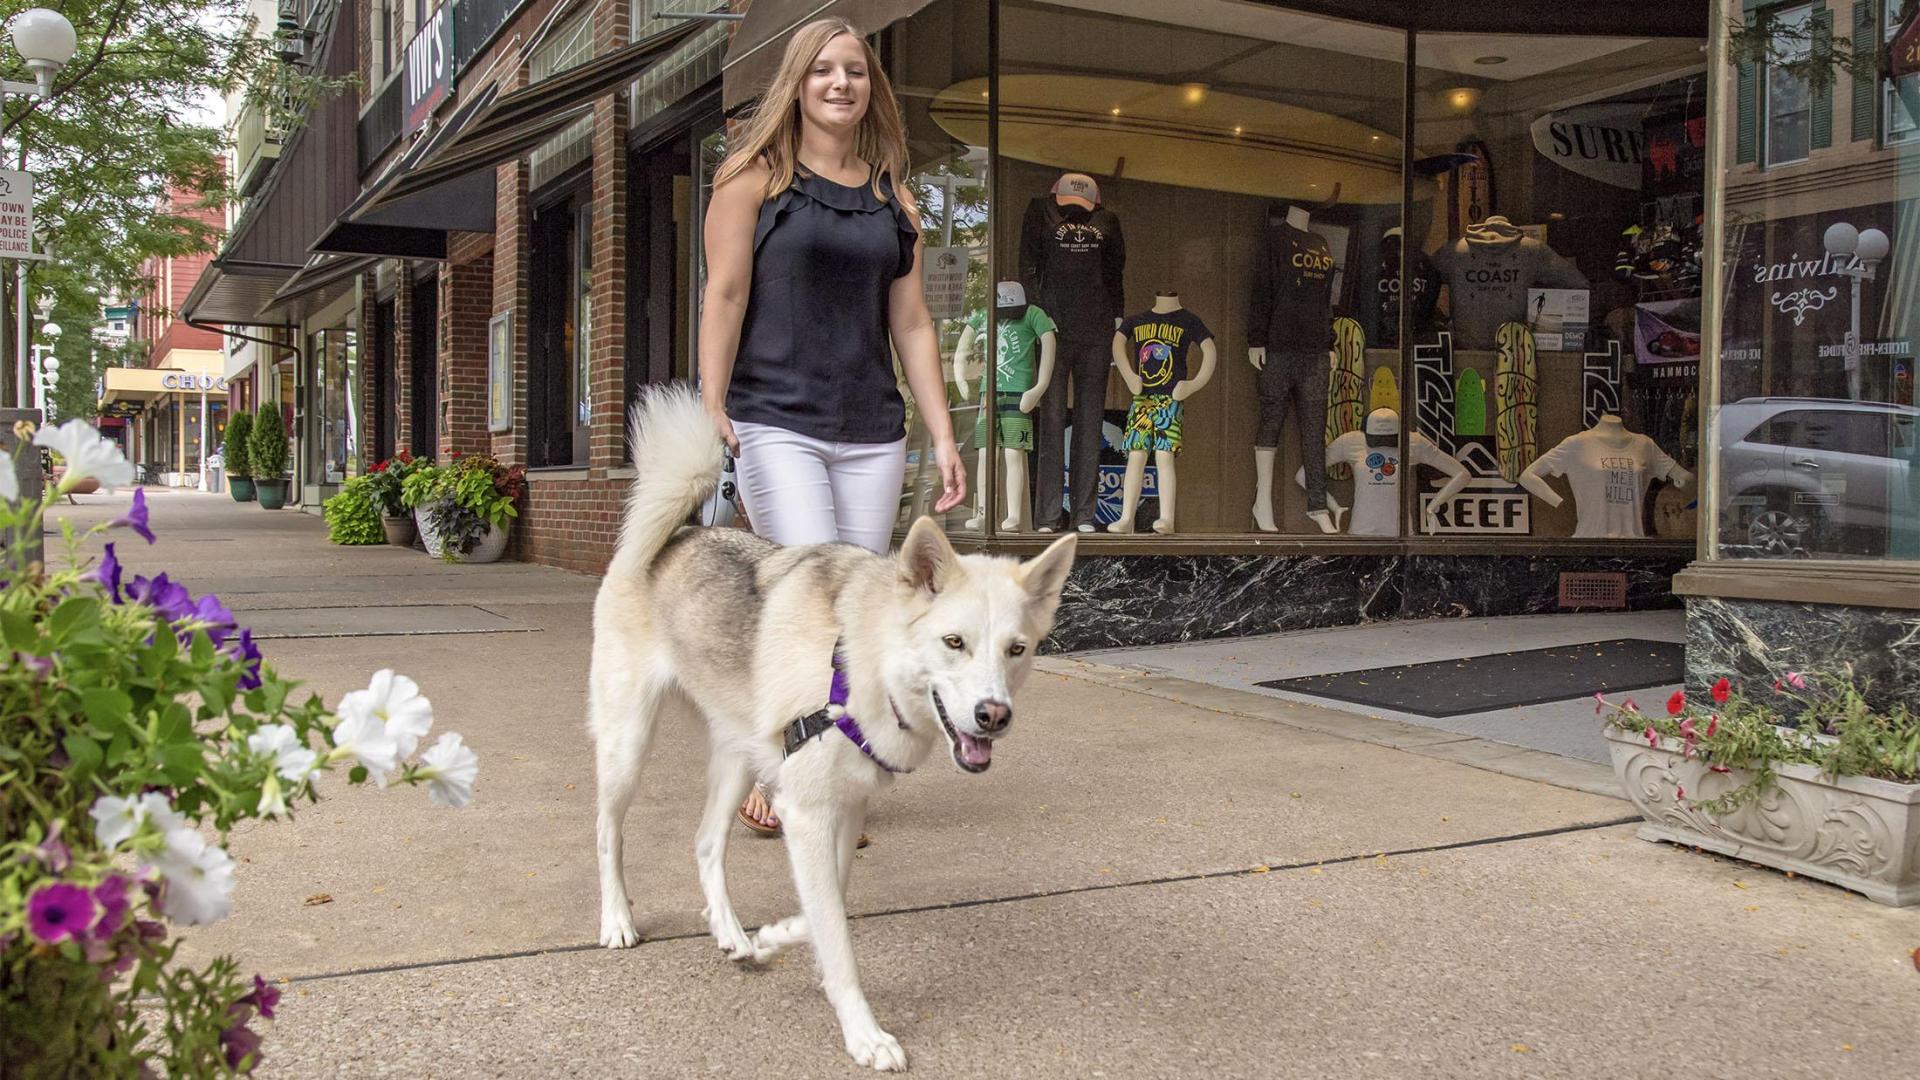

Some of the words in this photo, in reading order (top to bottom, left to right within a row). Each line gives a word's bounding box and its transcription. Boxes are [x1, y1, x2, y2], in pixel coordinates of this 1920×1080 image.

[409, 8, 443, 106] VIVI'S
[1550, 121, 1643, 164] SURF
[0, 202, 25, 213] OWN
[1, 215, 12, 225] AY
[15, 216, 28, 227] BE
[1055, 225, 1068, 241] LOST
[0, 241, 29, 252] EILLANCE
[1292, 253, 1333, 271] COAST
[1465, 270, 1520, 283] COAST
[1378, 278, 1427, 293] COST
[1134, 323, 1157, 342] THIRD
[1158, 323, 1184, 345] COAST
[1653, 366, 1697, 378] HAMMOC
[162, 374, 229, 391] CHOC
[1600, 457, 1633, 469] KEEP
[1611, 471, 1628, 484] ME
[1605, 486, 1633, 501] WILD
[1425, 499, 1523, 528] REEF
